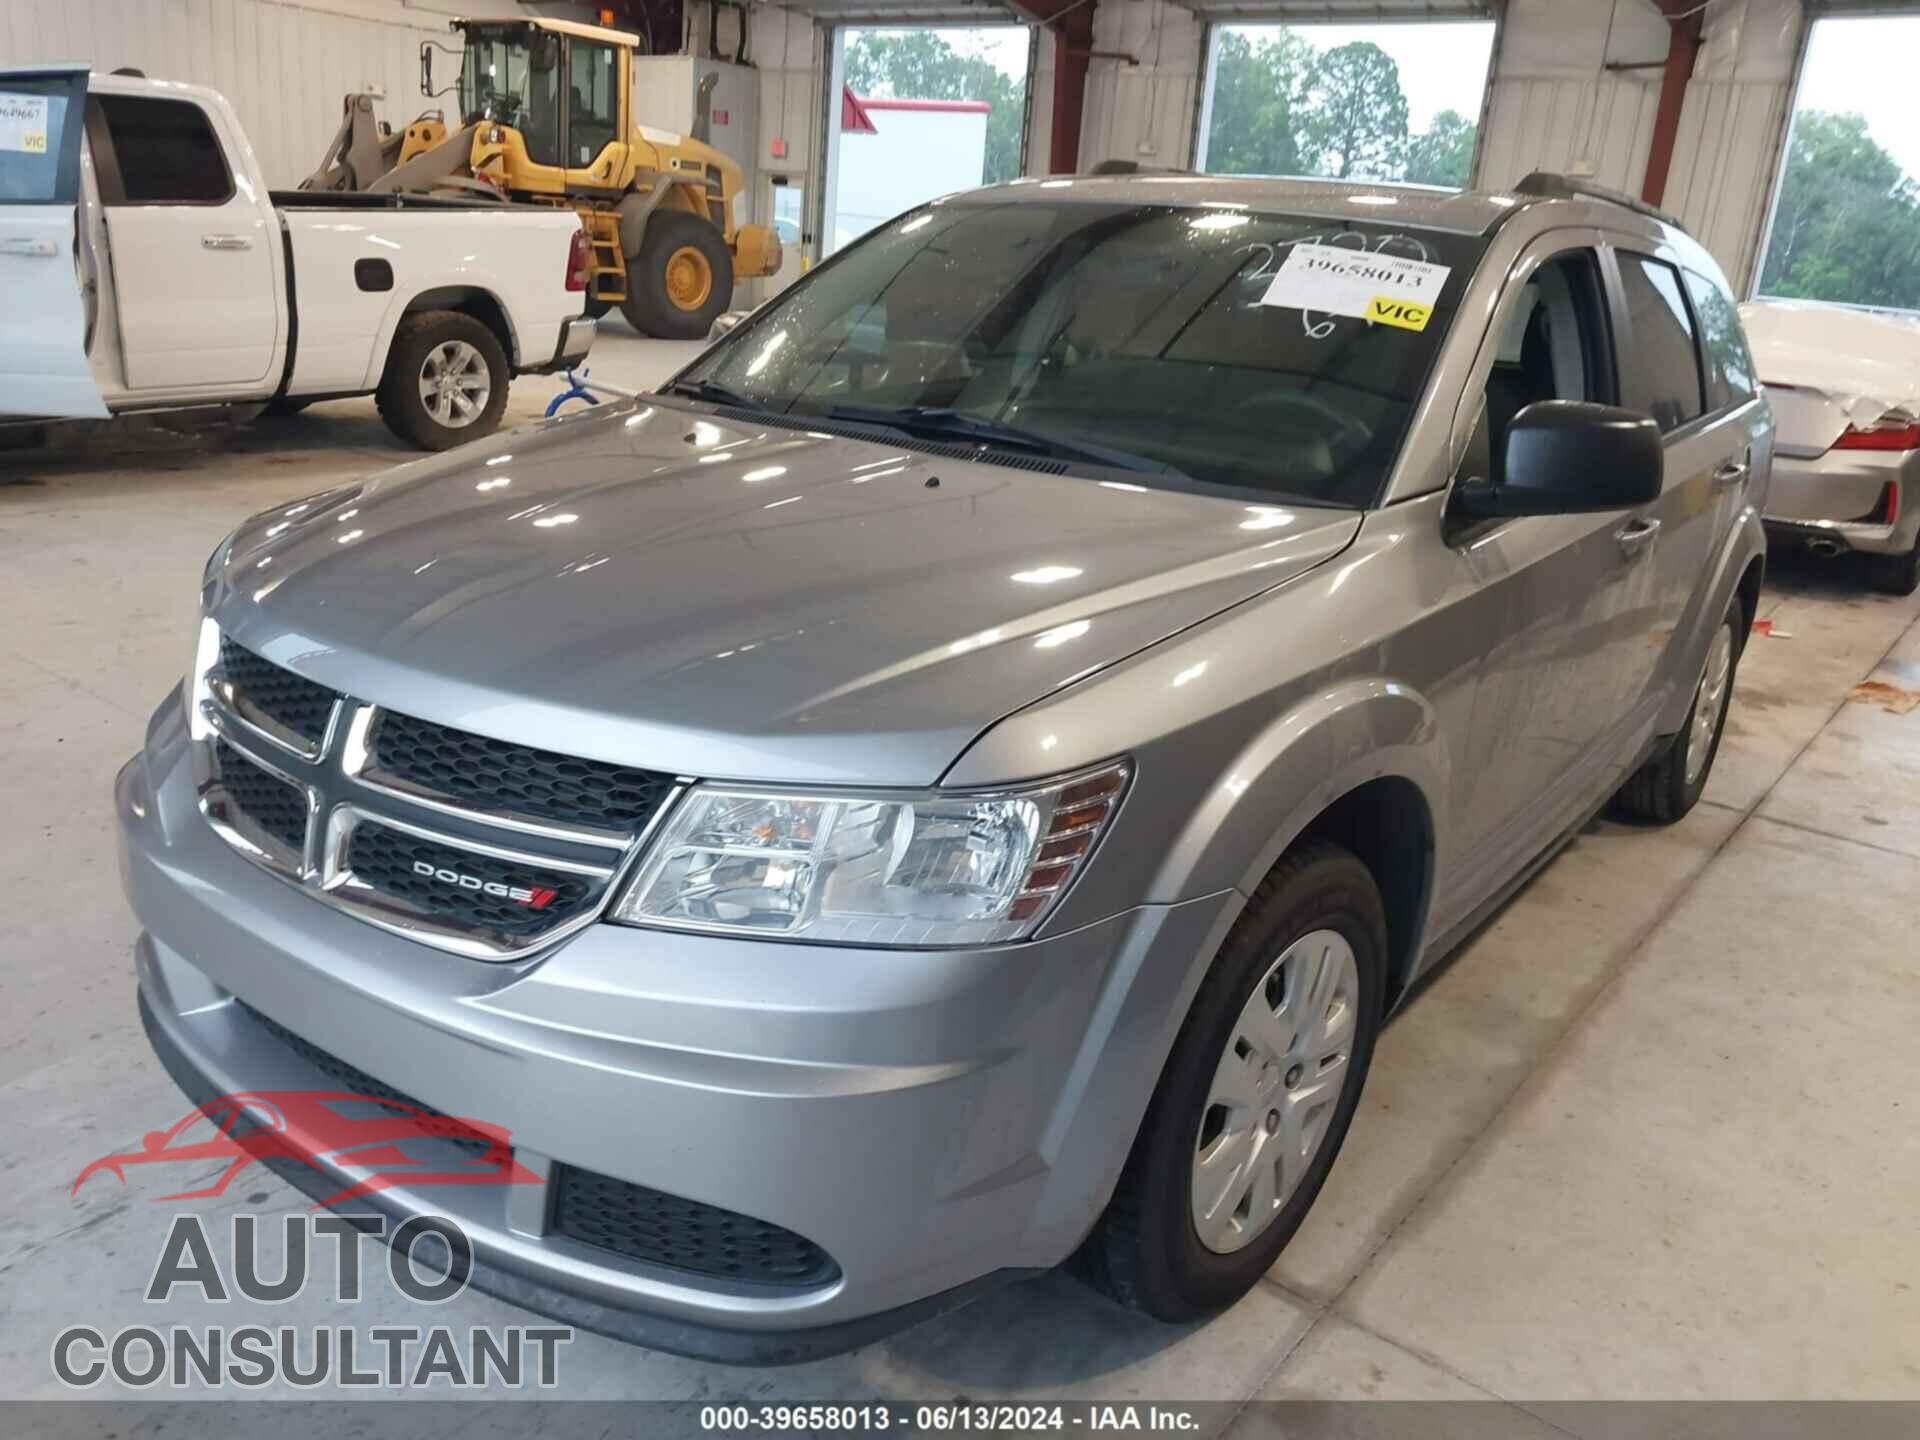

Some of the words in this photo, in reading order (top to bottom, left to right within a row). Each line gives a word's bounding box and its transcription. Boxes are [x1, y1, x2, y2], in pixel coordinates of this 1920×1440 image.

[1298, 257, 1425, 288] 39658013
[1374, 301, 1425, 324] VIC
[413, 860, 534, 904] DODGE
